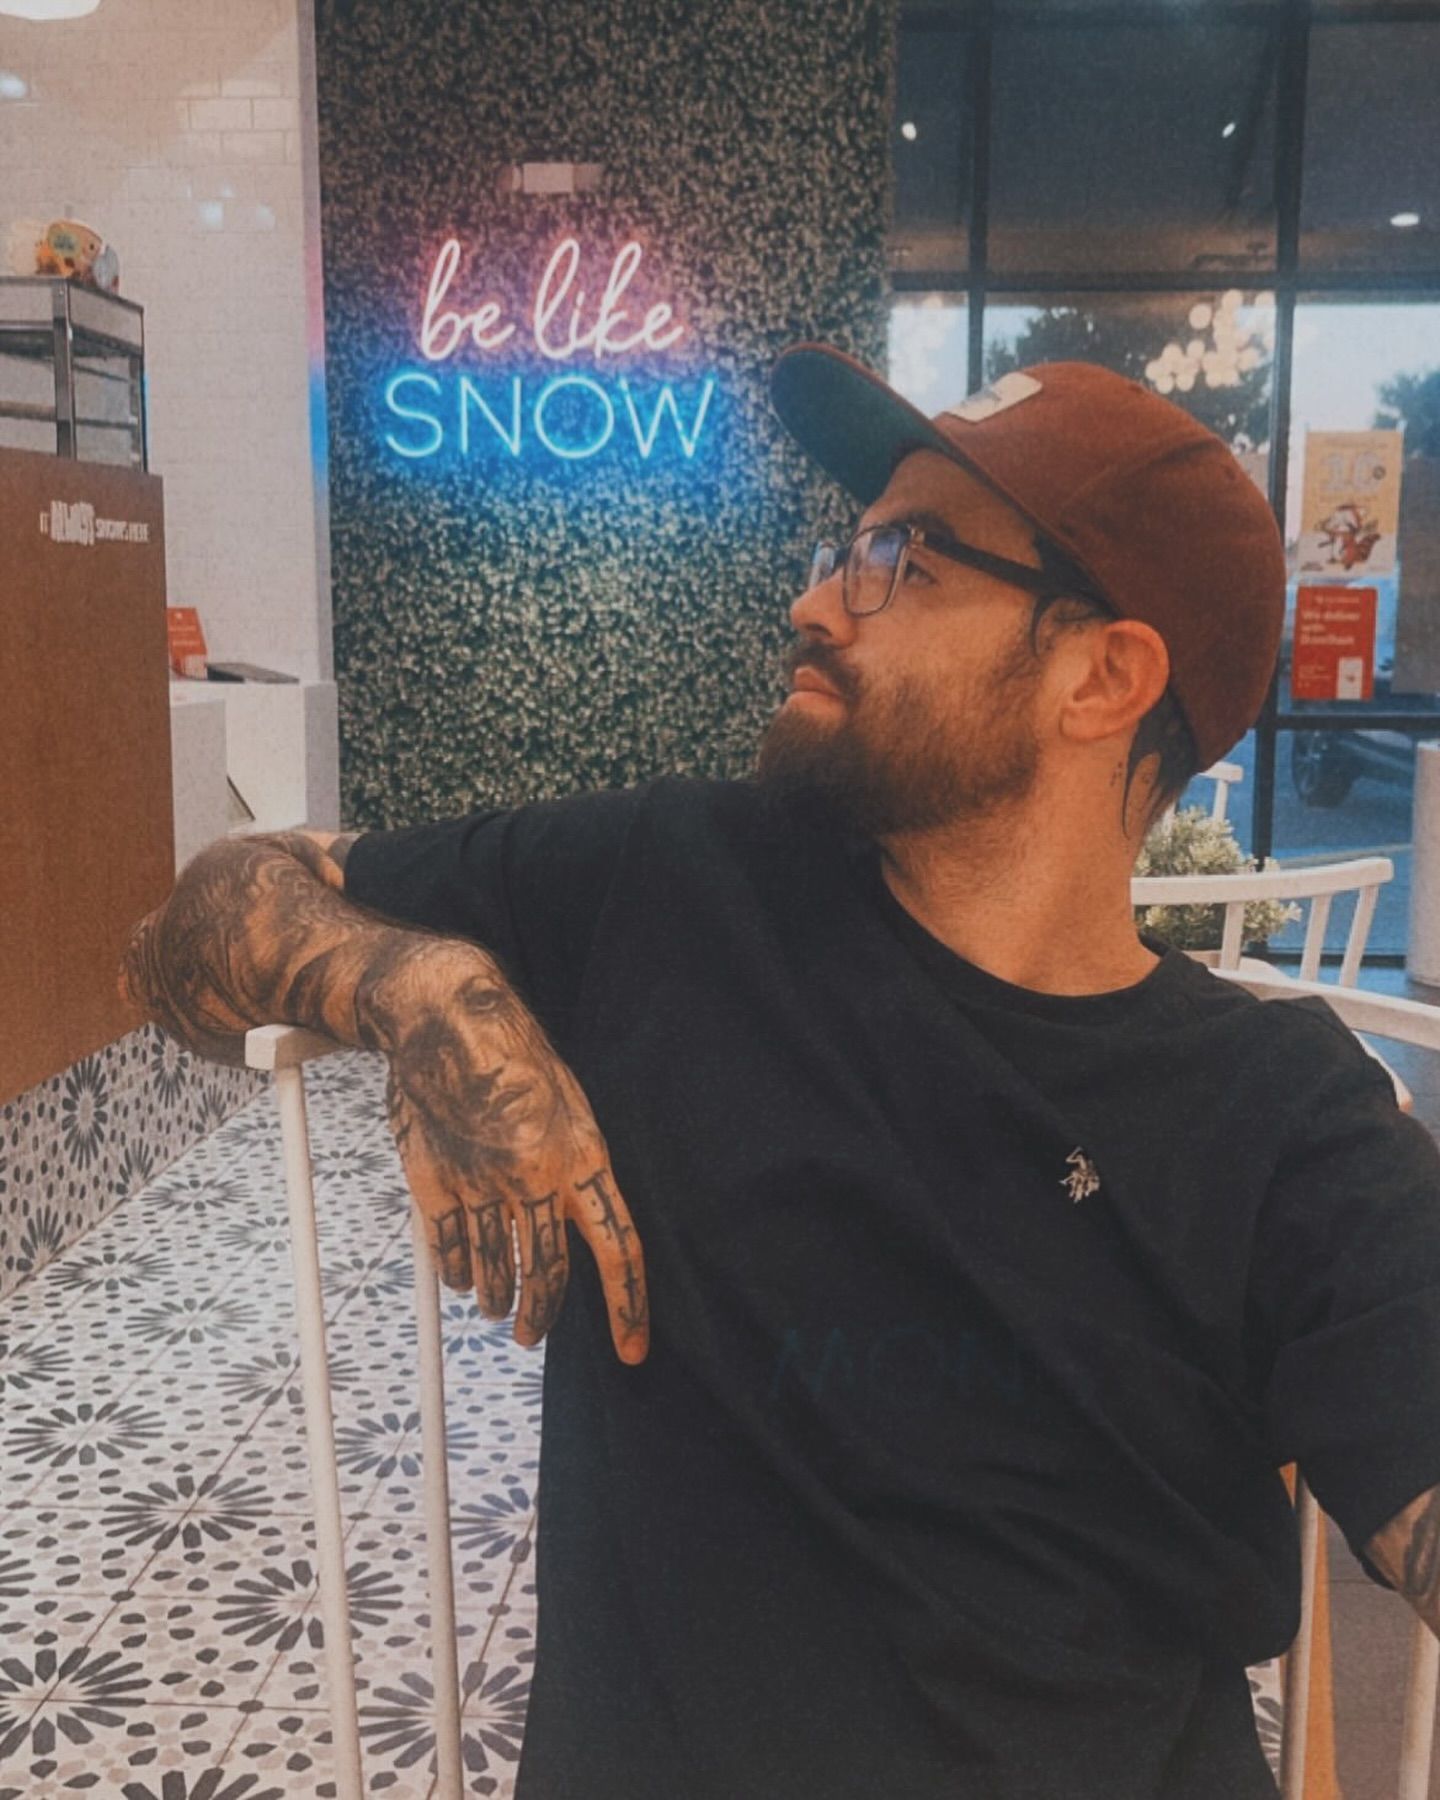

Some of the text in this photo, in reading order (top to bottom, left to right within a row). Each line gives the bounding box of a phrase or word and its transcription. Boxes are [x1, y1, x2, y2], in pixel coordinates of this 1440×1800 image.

[420, 238, 684, 361] be like
[385, 371, 716, 459] SNOW
